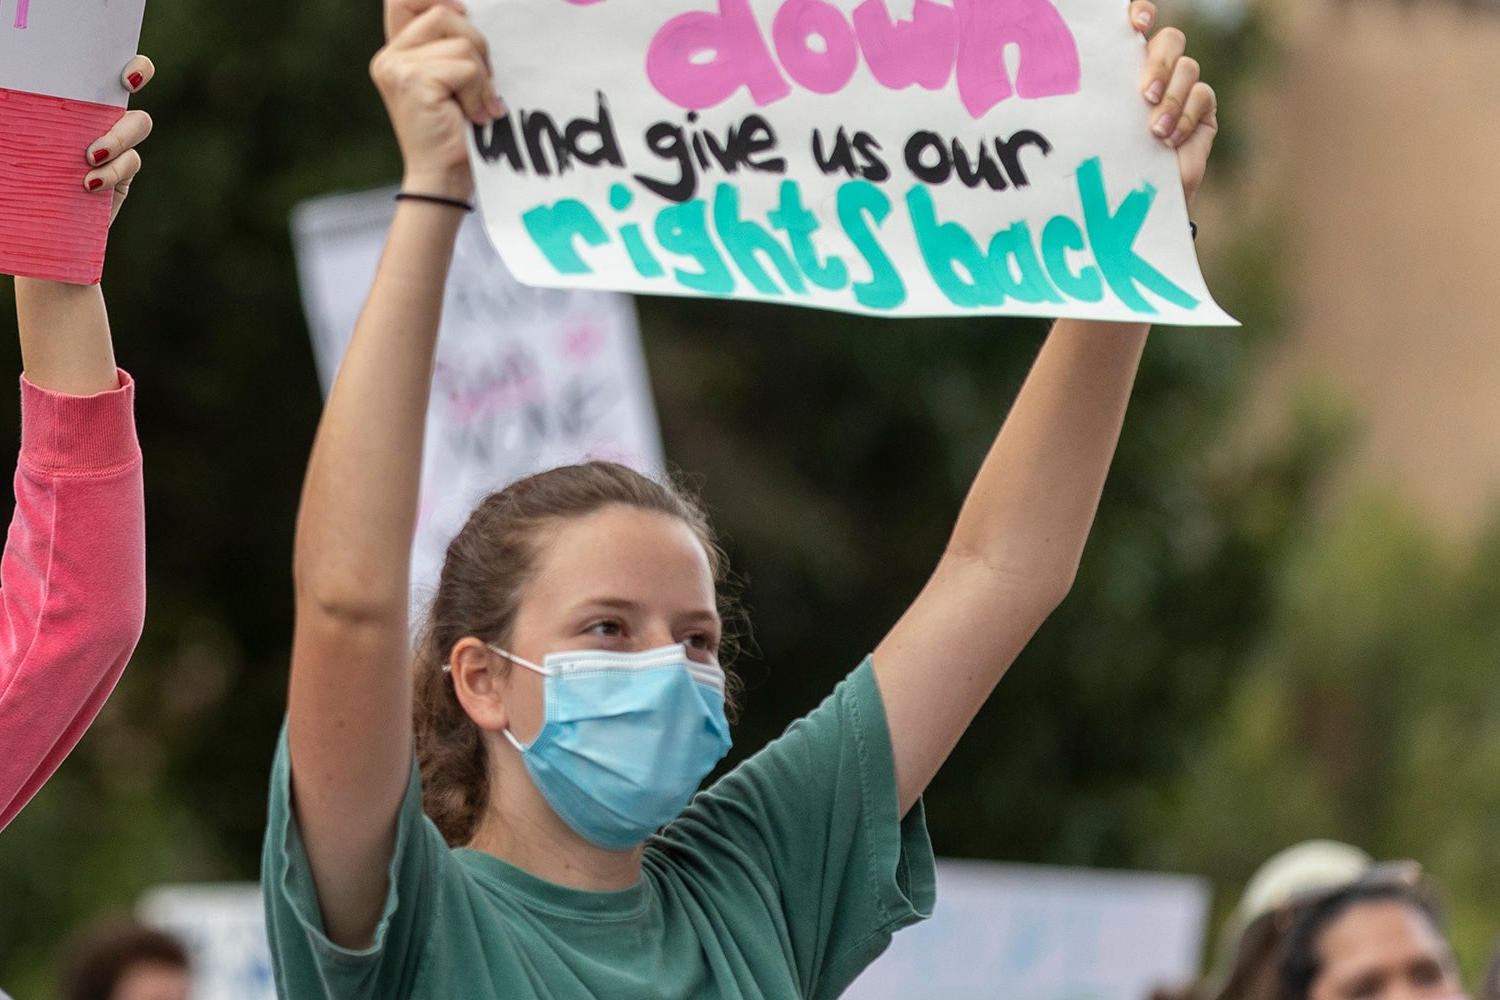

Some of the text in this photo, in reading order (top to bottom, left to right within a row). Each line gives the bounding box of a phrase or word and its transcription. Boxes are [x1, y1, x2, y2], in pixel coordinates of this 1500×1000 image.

[633, 110, 788, 201] give
[812, 125, 891, 182] us
[904, 130, 1051, 191] our
[906, 154, 1200, 314] back
